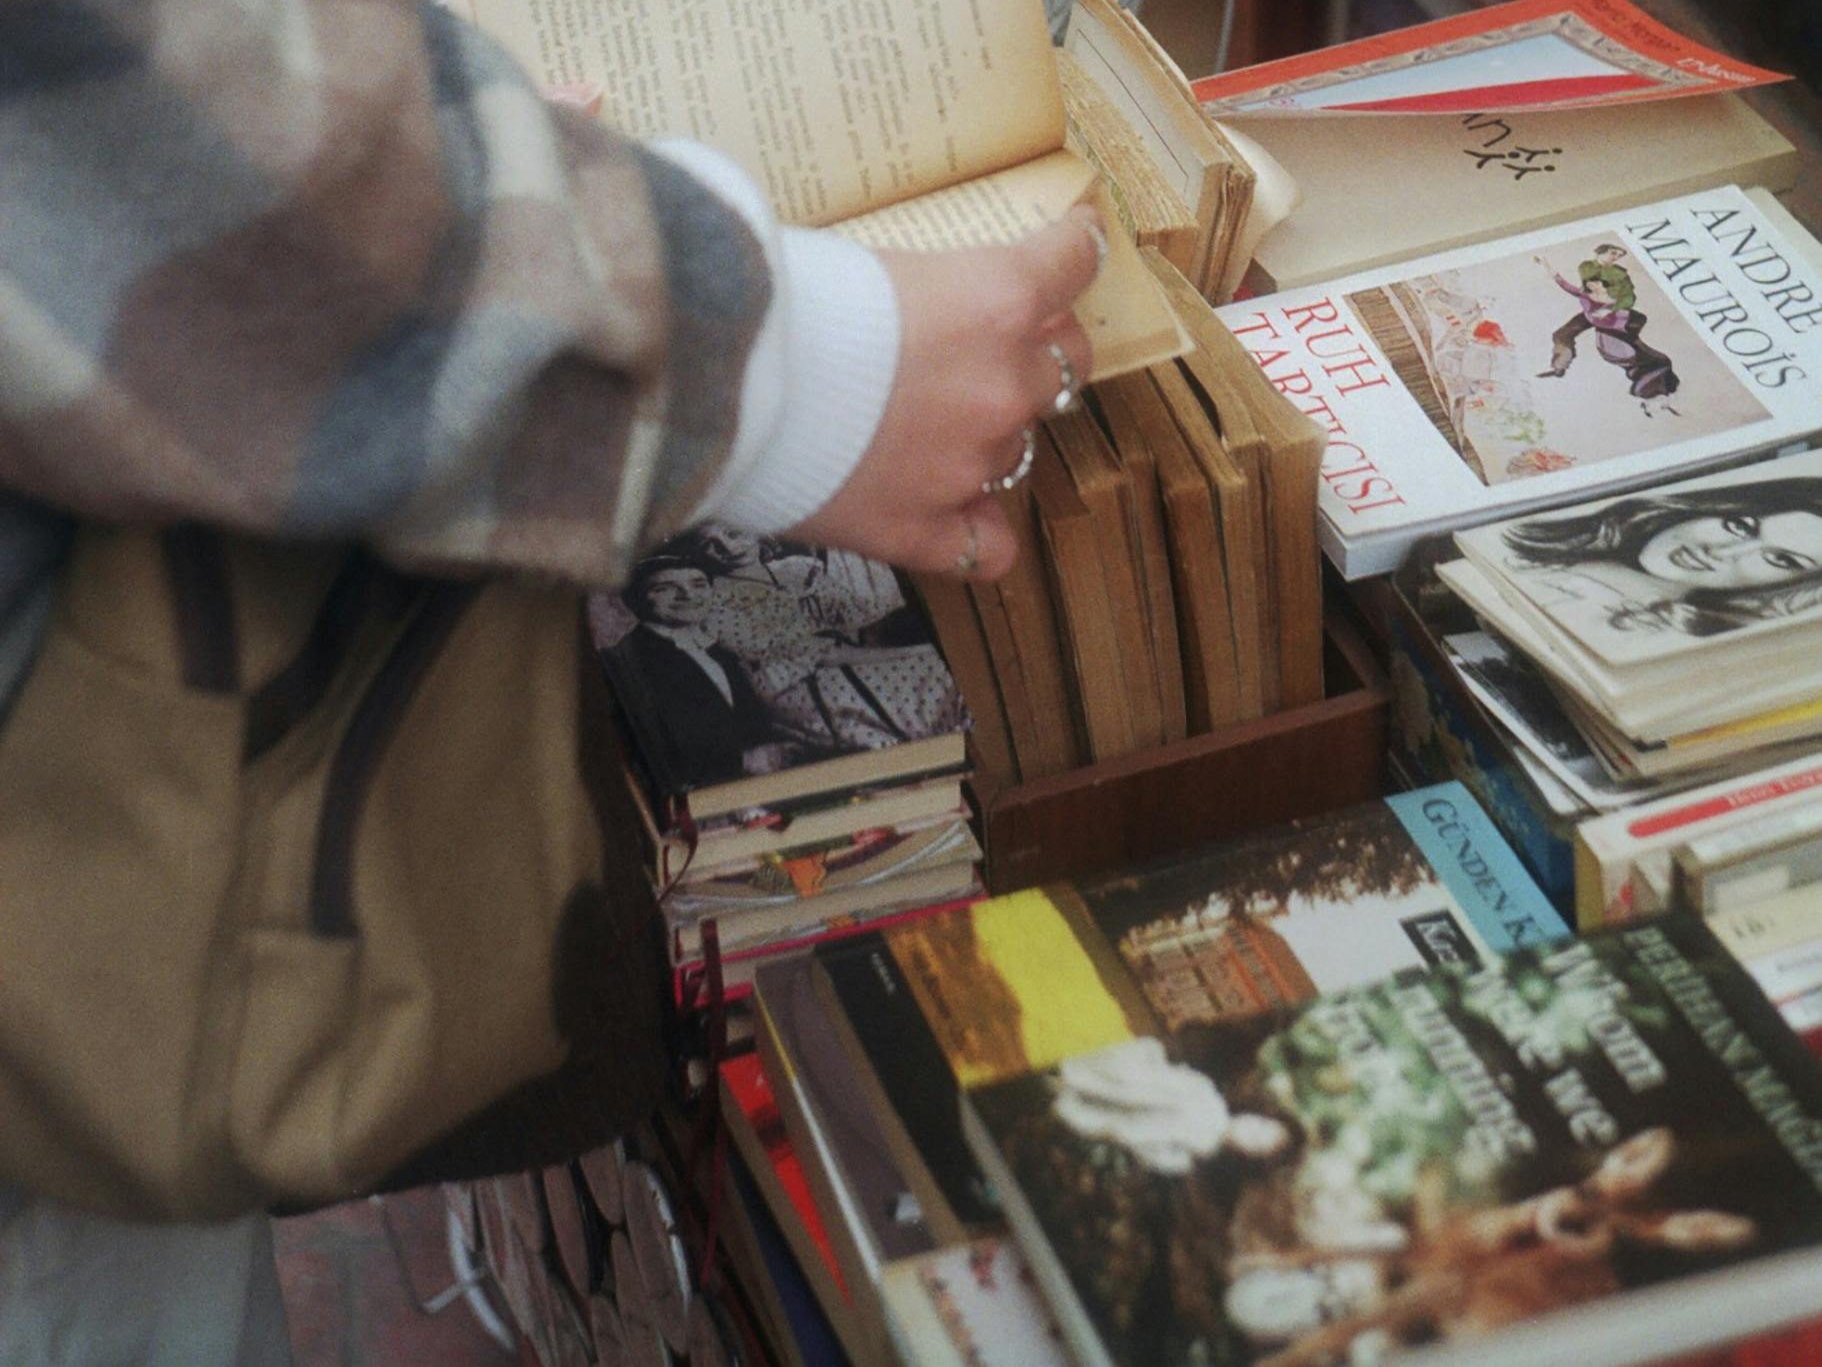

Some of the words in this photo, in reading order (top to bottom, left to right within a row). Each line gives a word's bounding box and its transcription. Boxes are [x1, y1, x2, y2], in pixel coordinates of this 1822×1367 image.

[1281, 296, 1391, 398] RUH
[1625, 218, 1808, 388] MAUROİS
[1543, 940, 1668, 1096] Whom
[1544, 1067, 1619, 1145] we
